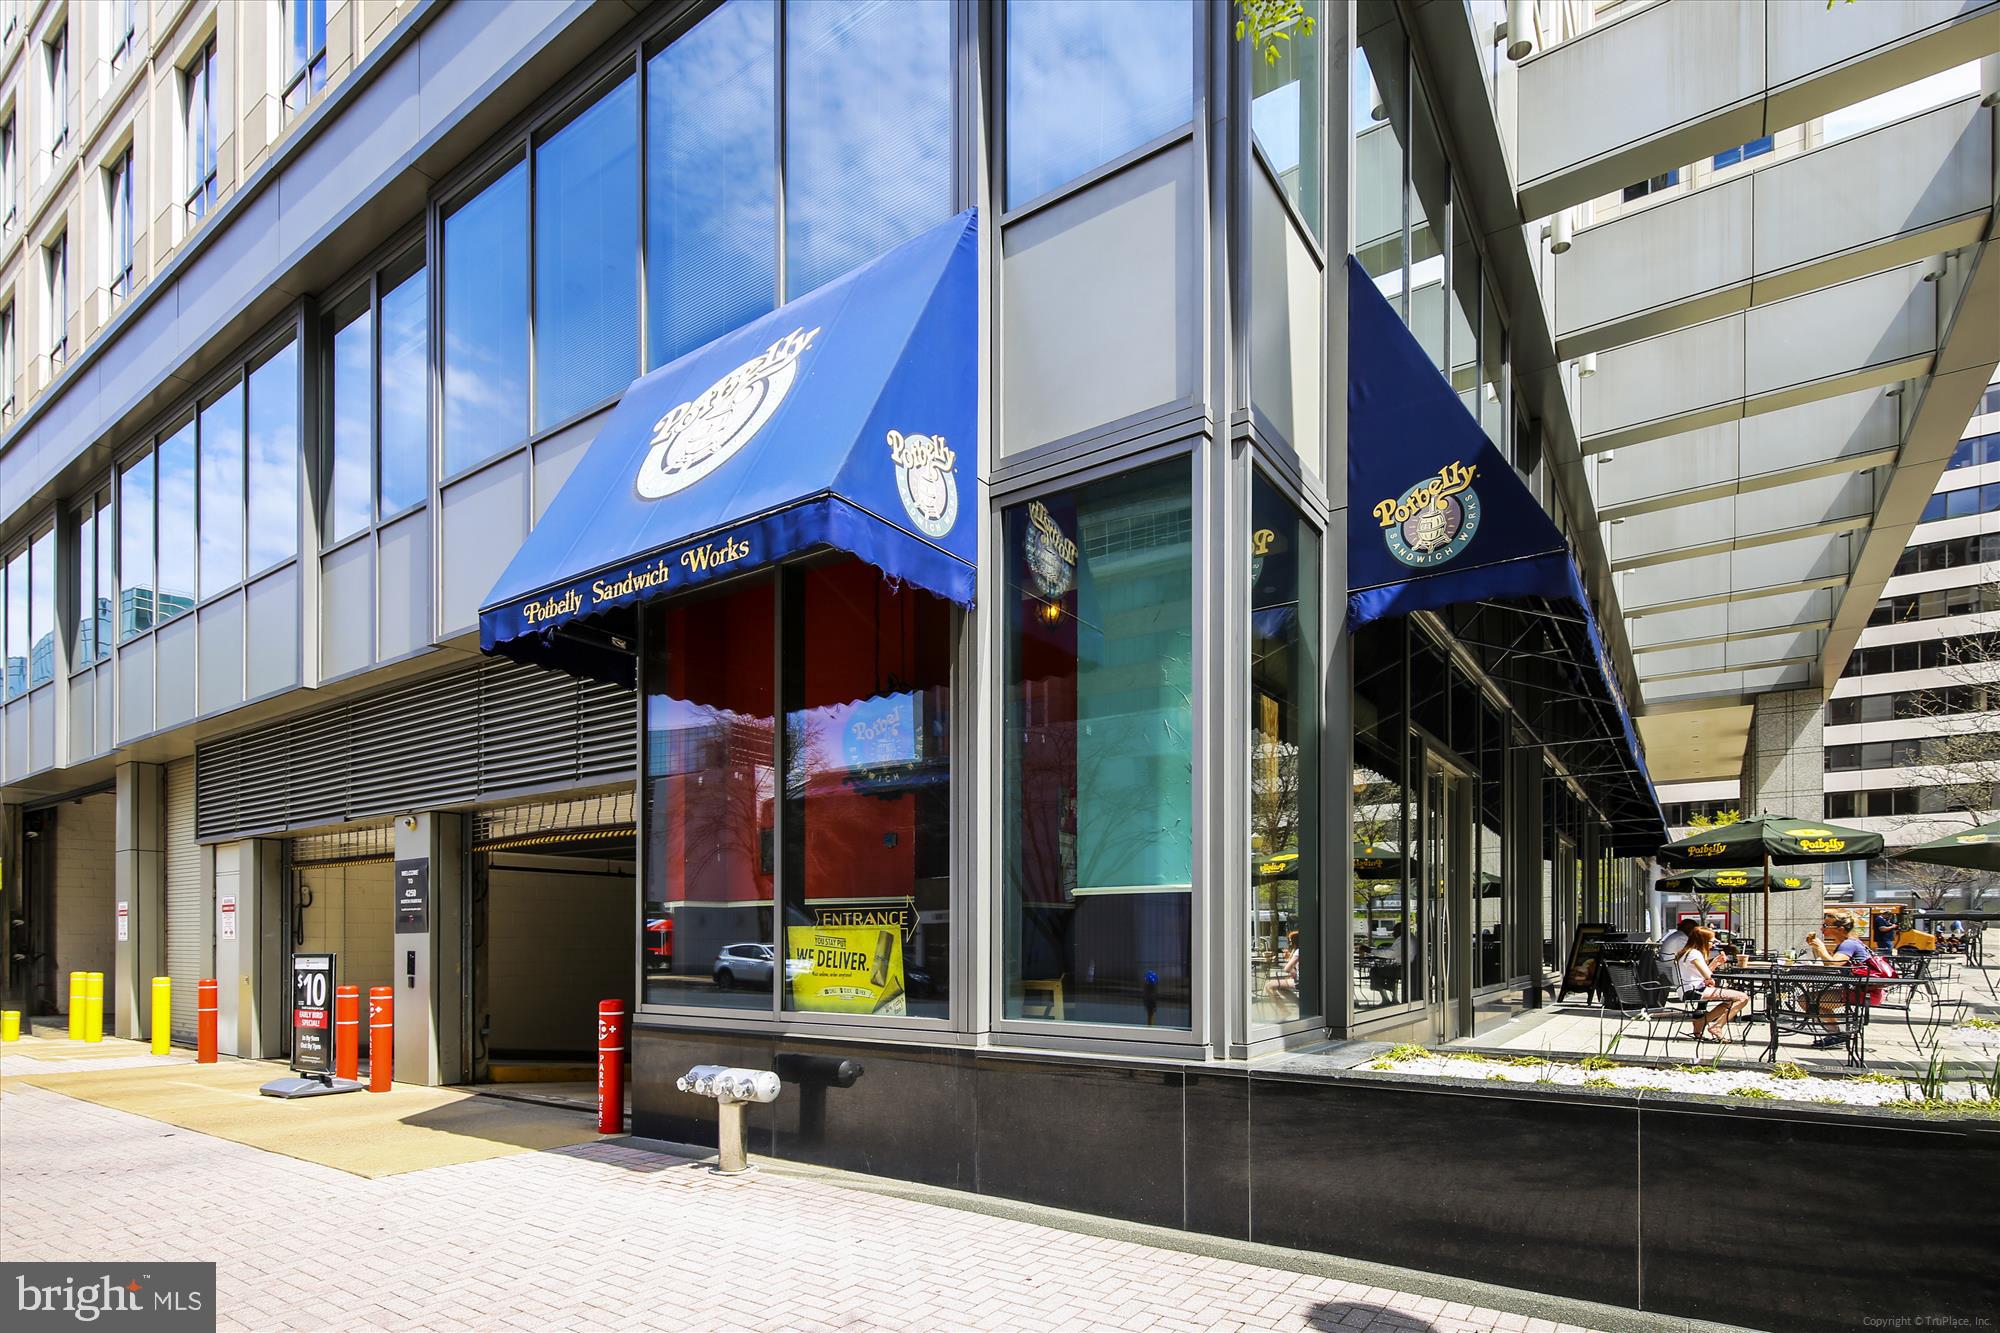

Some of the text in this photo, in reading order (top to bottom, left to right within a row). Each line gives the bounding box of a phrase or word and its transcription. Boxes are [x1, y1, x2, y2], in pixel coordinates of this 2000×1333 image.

[887, 429, 956, 480] Potbelly
[1373, 461, 1477, 527] Potbelly
[1389, 494, 1477, 563] SANDWICH WORKS
[523, 536, 750, 624] Potbelly Sandwich Works
[852, 705, 904, 740] Potbel
[1800, 838, 1846, 853] Potbelly
[822, 911, 909, 926] ENTRANCE
[797, 947, 870, 972] WE DELIVER.
[297, 972, 327, 1007] $10
